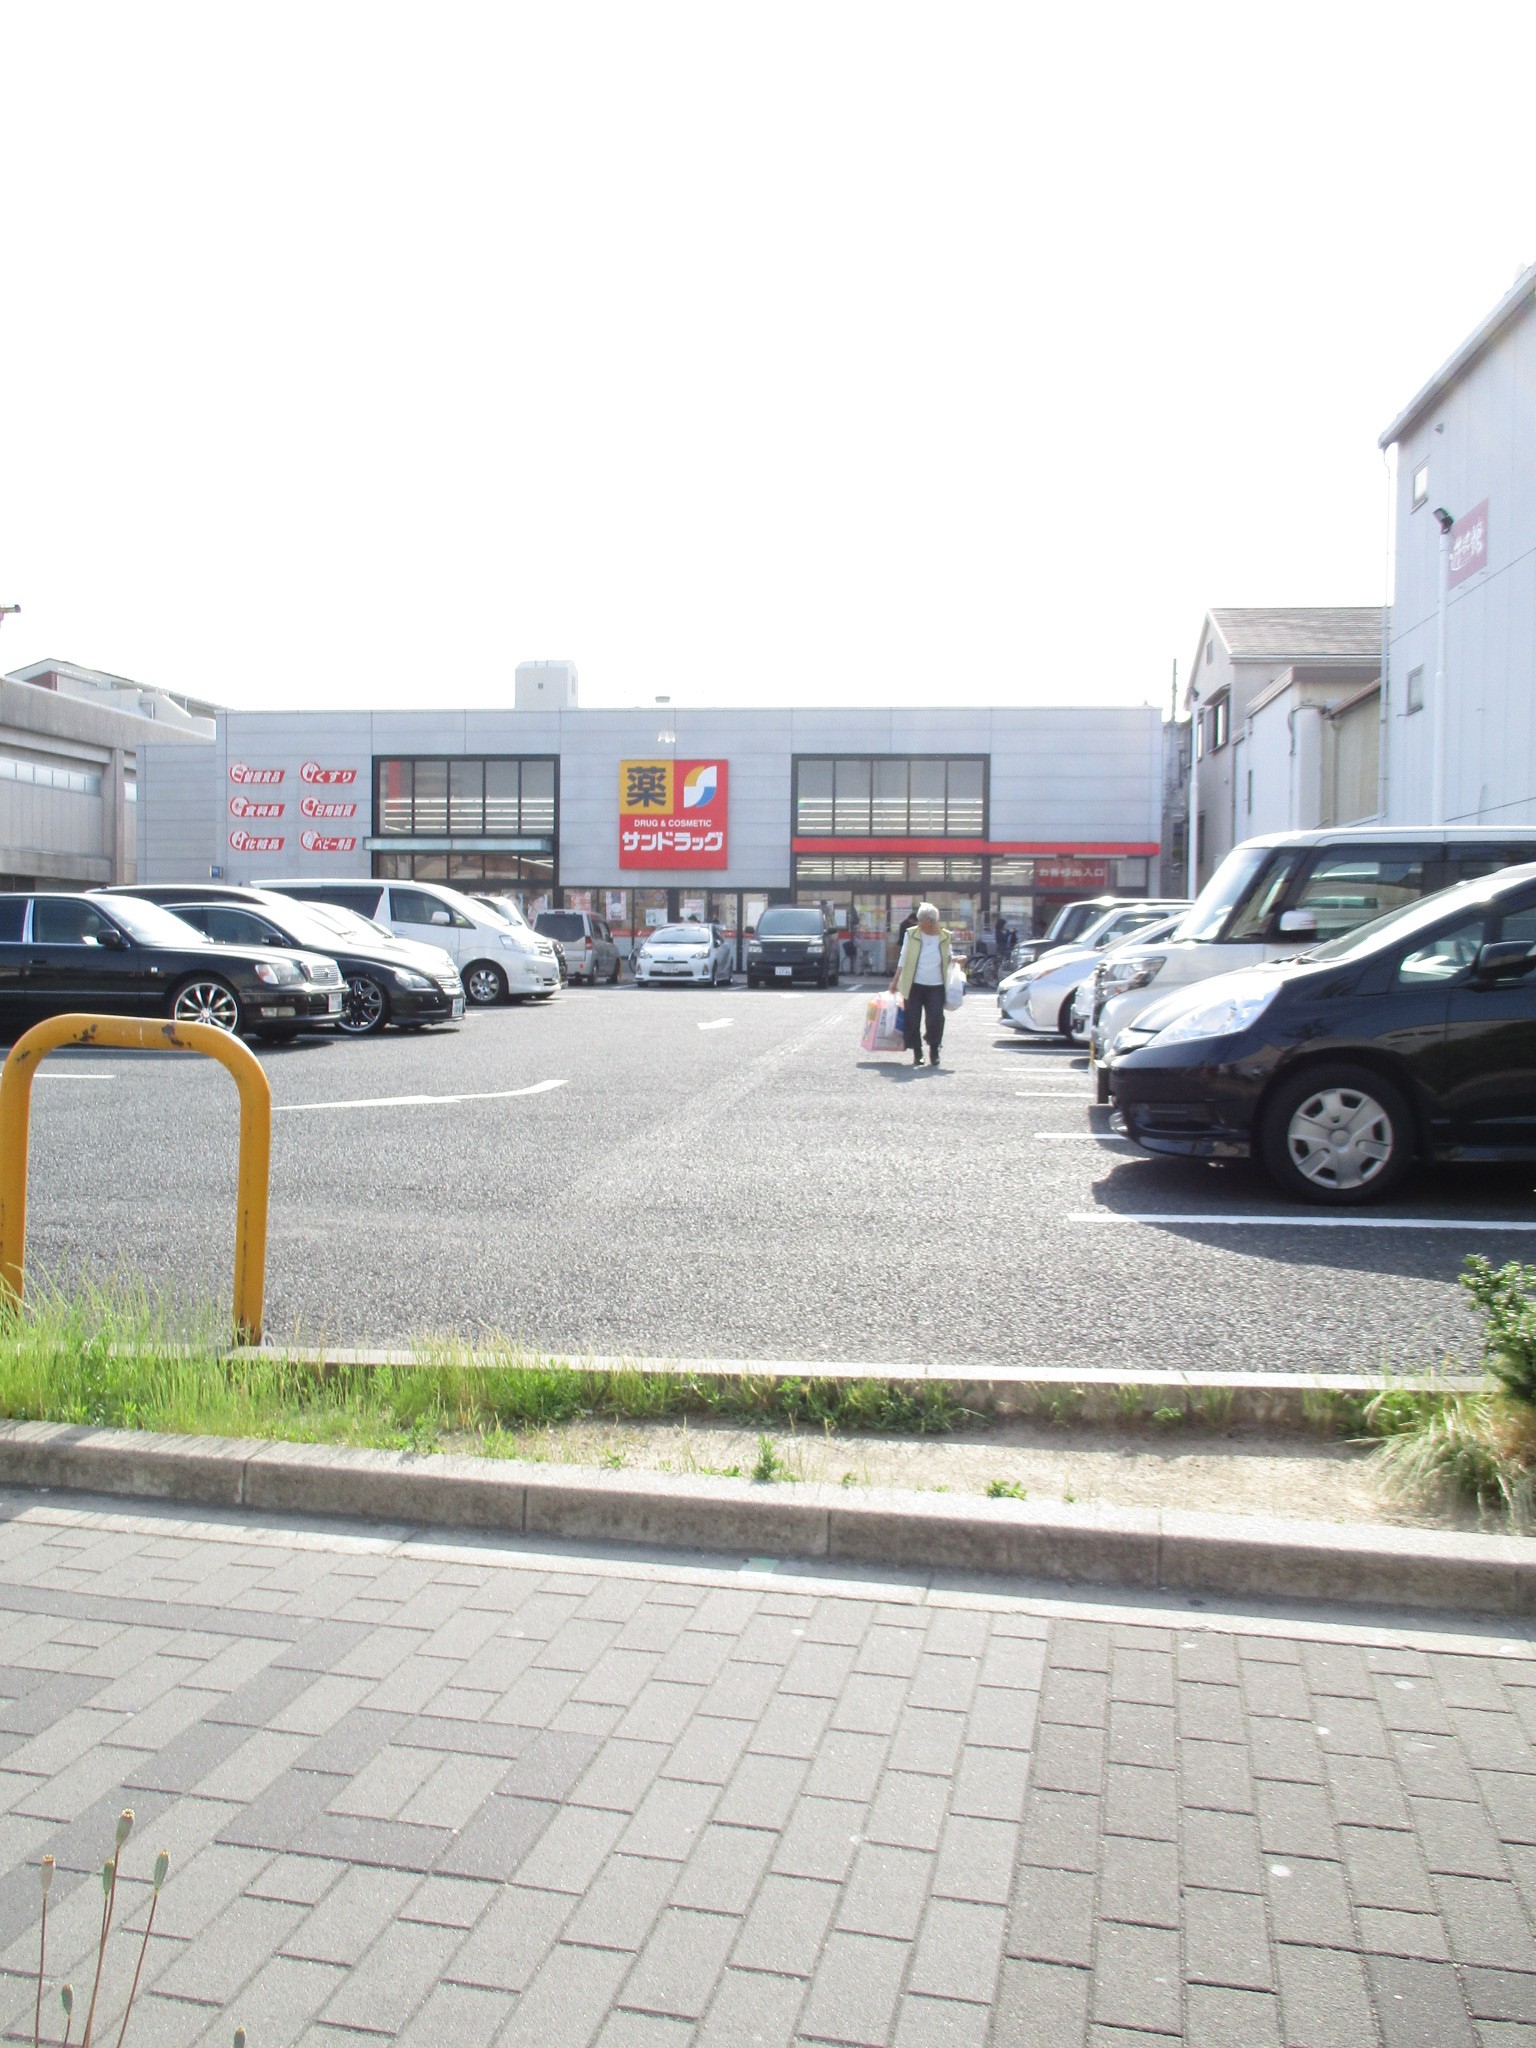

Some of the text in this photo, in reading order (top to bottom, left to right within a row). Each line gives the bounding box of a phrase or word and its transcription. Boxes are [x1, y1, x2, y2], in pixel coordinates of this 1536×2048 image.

[316, 771, 353, 783] くすり
[626, 766, 667, 808] 薬
[245, 805, 280, 817] 食料品
[634, 819, 712, 827] DRUG & COSMETIC
[245, 838, 280, 850] 化粧品
[315, 839, 353, 850] ベビー用品
[622, 832, 724, 851] サンドラッグ
